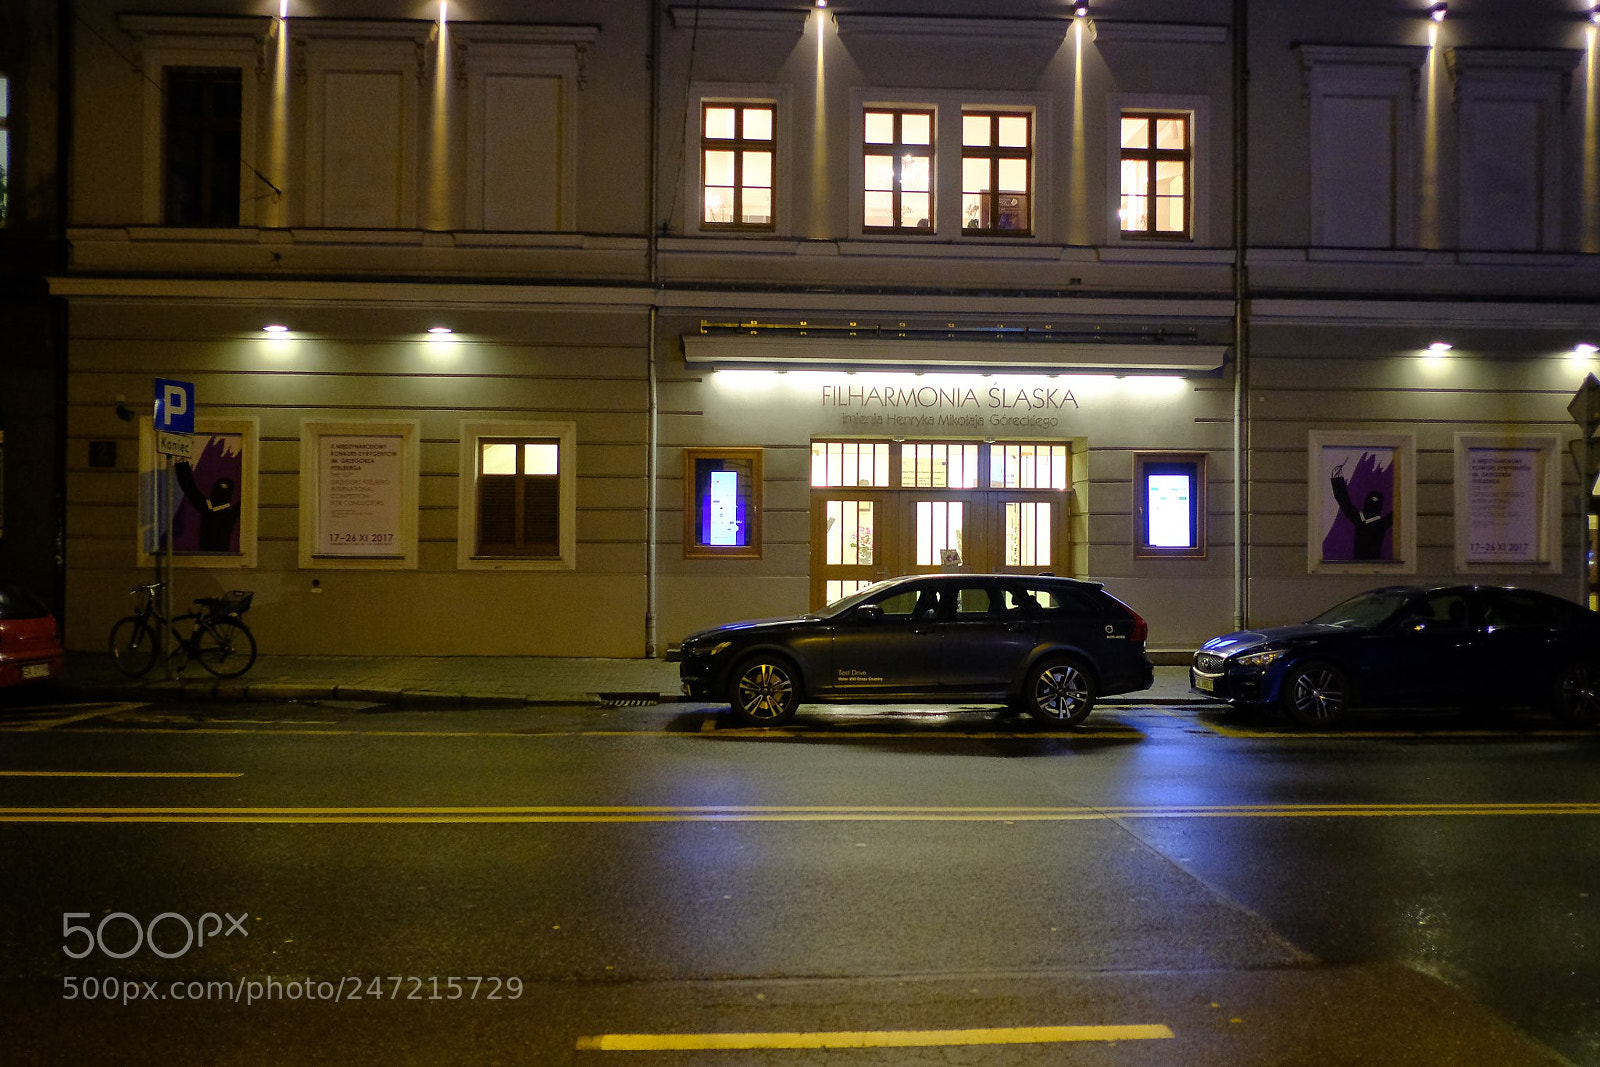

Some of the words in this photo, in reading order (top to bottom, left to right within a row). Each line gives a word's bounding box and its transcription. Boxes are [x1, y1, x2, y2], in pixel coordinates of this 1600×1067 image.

[164, 384, 187, 425] P
[822, 385, 980, 408] FILHARMONIA
[988, 382, 1079, 411] ŚLĄSKA
[842, 412, 883, 425] imienia
[886, 413, 935, 427] Henryka
[989, 413, 1059, 429] Góreckiego
[161, 436, 190, 453] Koniec
[371, 533, 394, 542] 2017
[1509, 543, 1528, 551] 2017
